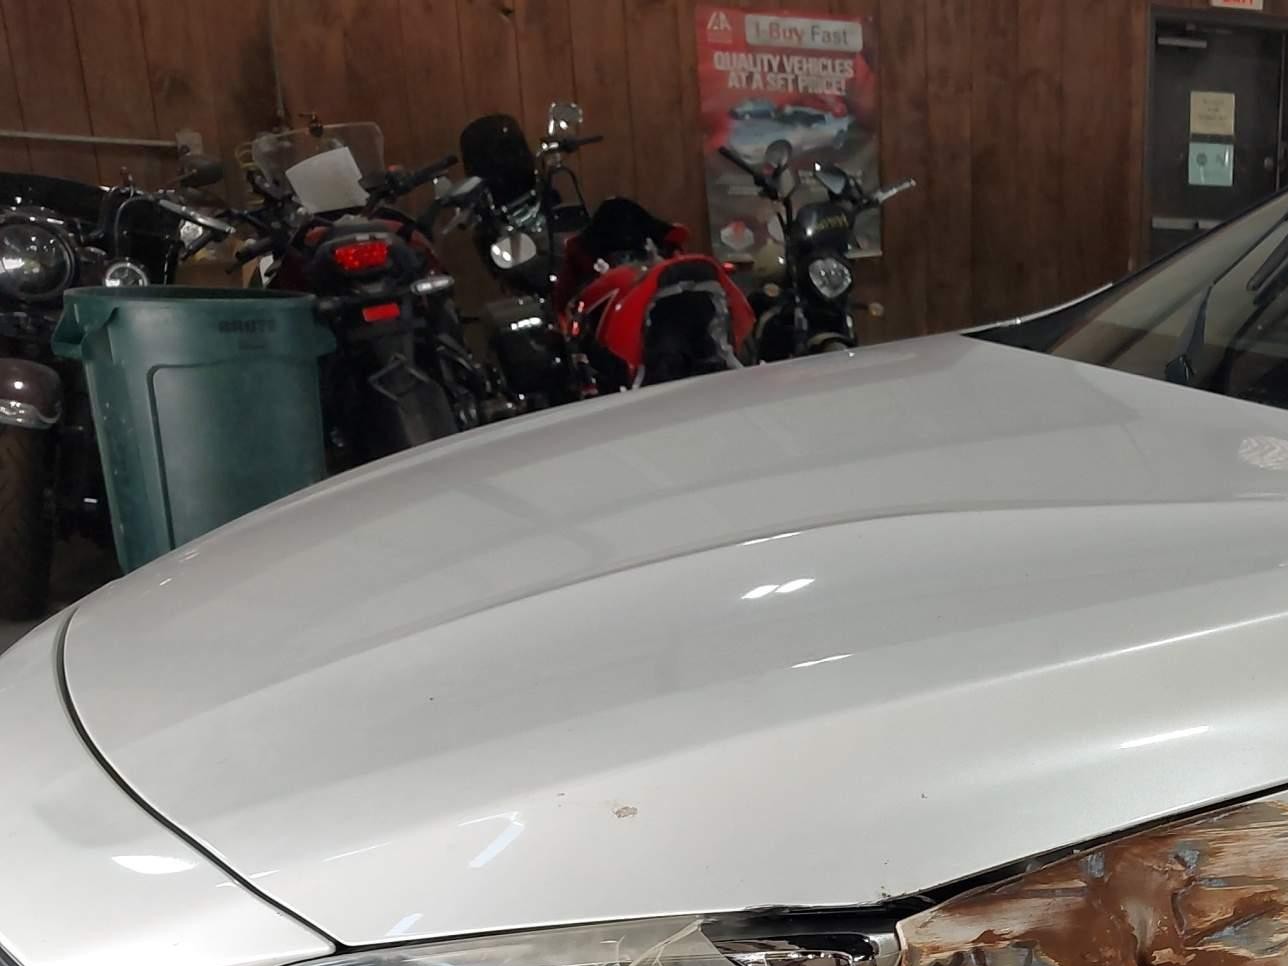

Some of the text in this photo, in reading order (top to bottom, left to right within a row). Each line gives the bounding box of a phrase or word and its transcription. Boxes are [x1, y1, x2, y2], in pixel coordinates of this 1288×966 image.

[811, 24, 849, 46] Fast
[714, 52, 854, 78] QUALITY VEHICLES
[728, 71, 848, 96] AT A SET PRICE!
